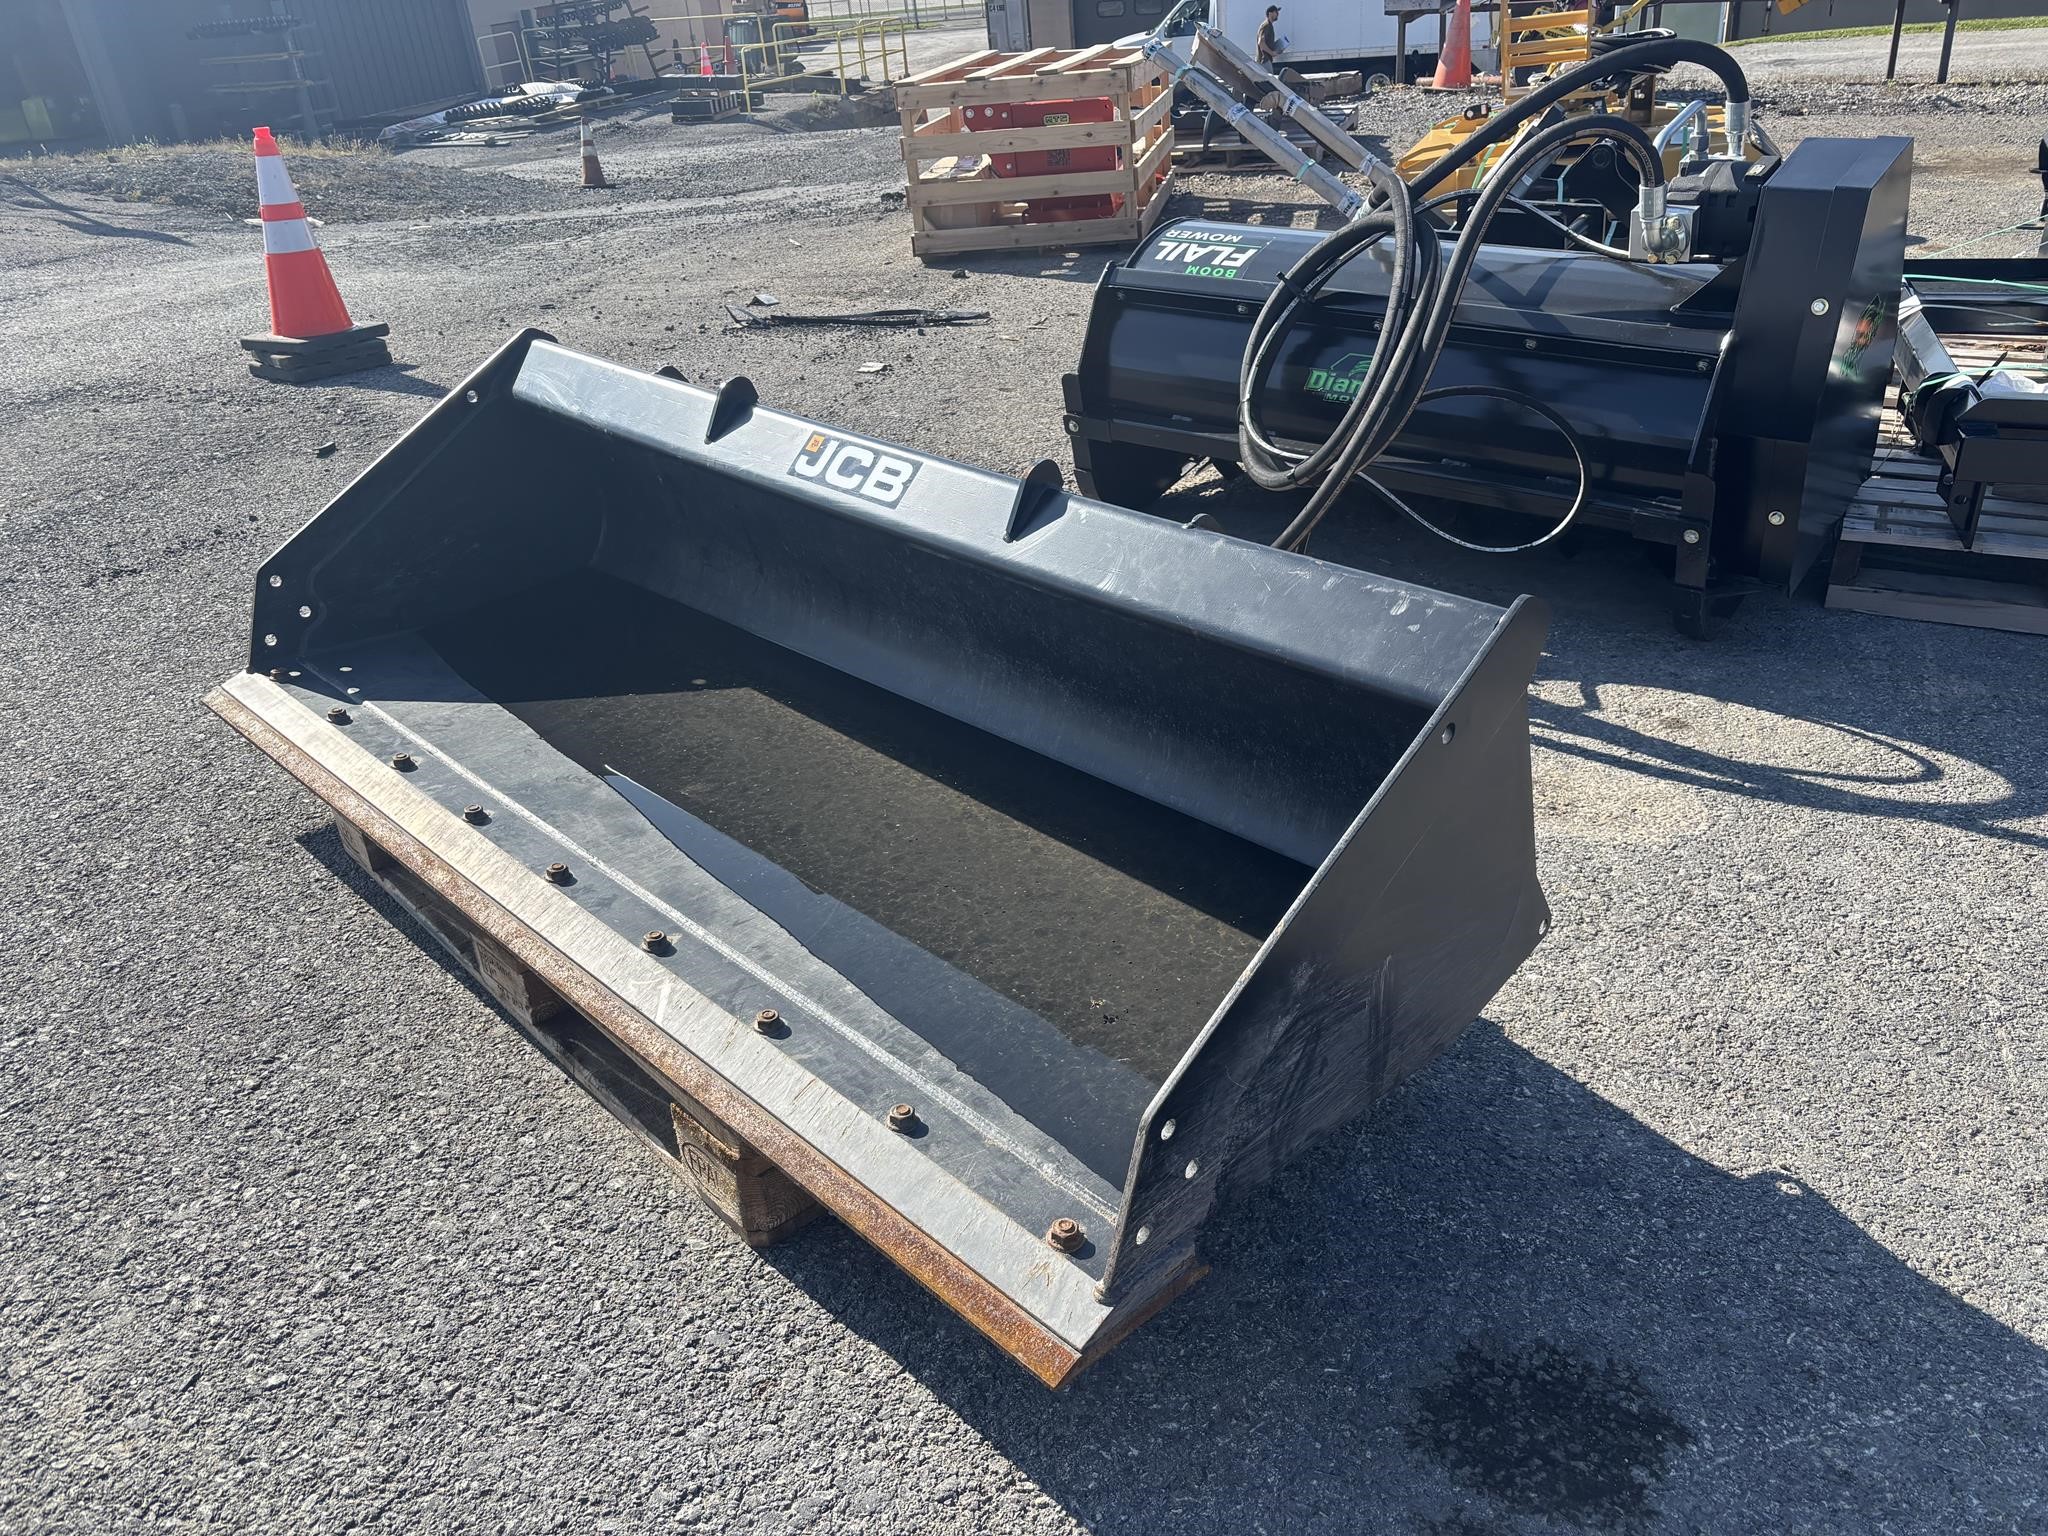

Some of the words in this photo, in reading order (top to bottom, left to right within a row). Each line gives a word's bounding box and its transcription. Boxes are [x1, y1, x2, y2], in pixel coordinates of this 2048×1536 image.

[1165, 229, 1243, 243] MOWER
[1154, 241, 1258, 267] FLAIL
[1185, 265, 1237, 278] BOOM
[794, 439, 914, 502] JCB
